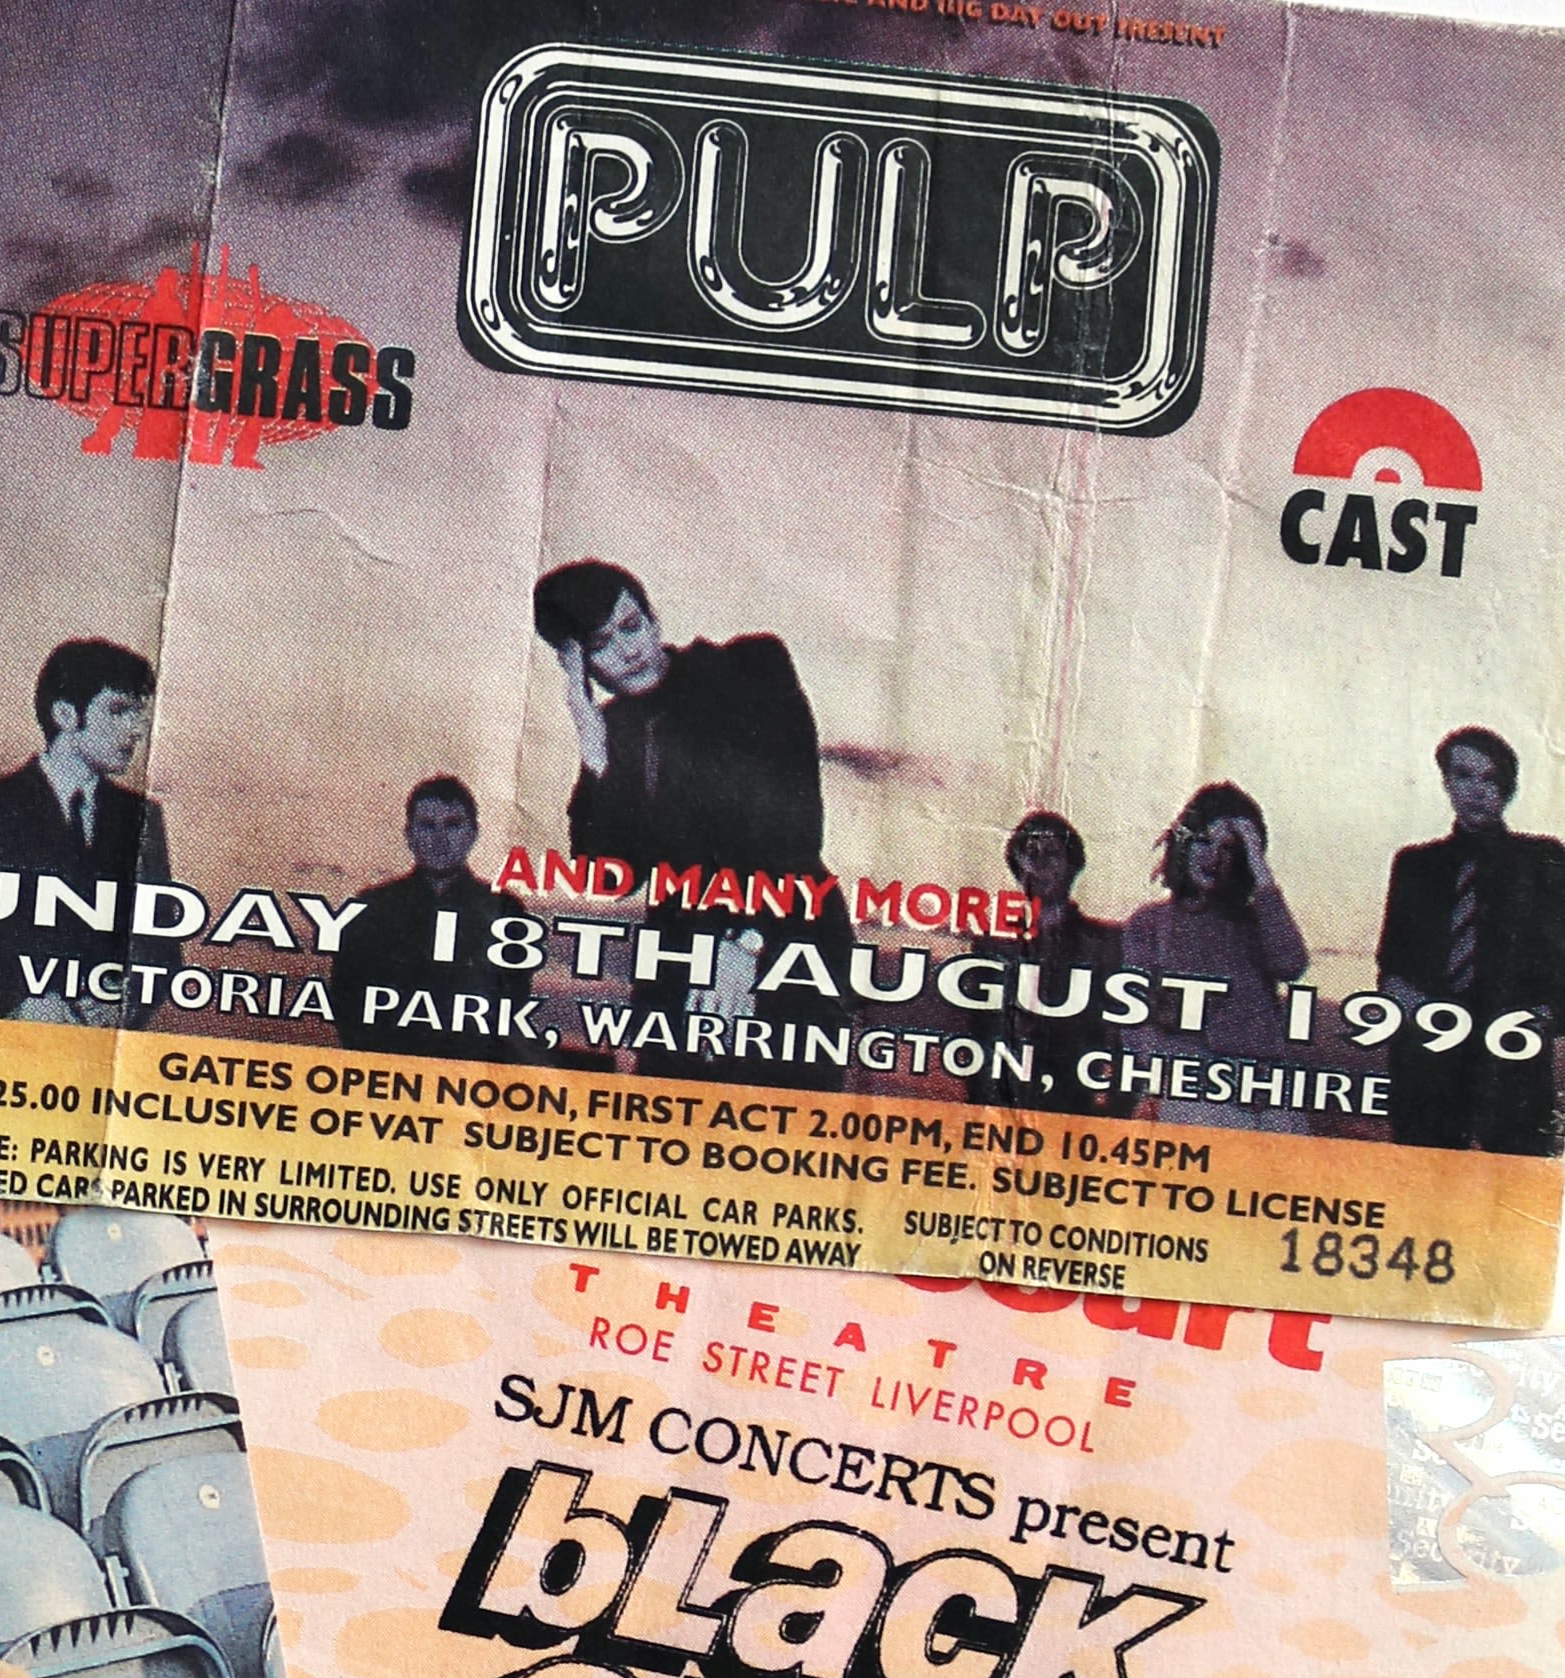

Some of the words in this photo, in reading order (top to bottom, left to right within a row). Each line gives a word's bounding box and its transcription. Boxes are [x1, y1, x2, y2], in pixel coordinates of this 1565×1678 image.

[533, 103, 1146, 357] PULP
[1279, 488, 1478, 579] CAST
[492, 846, 634, 900] AND
[648, 862, 839, 920] MANY
[850, 876, 1041, 941] MORE!
[20, 956, 335, 1022] VICTORIA
[364, 986, 560, 1051] PARK,
[581, 1000, 1055, 1097] WARRINGTON,
[1076, 1053, 1392, 1117] CHESHIRE
[432, 906, 717, 988] 18TH
[761, 940, 1230, 1032] AUGUST
[1287, 984, 1543, 1061] 1996
[93, 1085, 297, 1133] INCLUSIVE
[310, 1108, 365, 1139] OF
[372, 1114, 444, 1144] VAT
[464, 1120, 636, 1162] SUBJECT
[702, 1143, 888, 1182] BOOKING
[901, 1158, 976, 1190] FEE.
[992, 1167, 1157, 1208] SUBJECT
[1226, 1188, 1386, 1229] LICENSE
[159, 1053, 292, 1091] GATES
[306, 1068, 422, 1103] OPEN
[437, 1077, 579, 1121] NOON,
[587, 1087, 703, 1127] FIRST
[709, 1101, 797, 1135] ACT
[809, 1109, 953, 1154] 2.00PM,
[963, 1121, 1044, 1155] END
[1061, 1132, 1211, 1172] 10.45PM
[30, 1138, 148, 1172] PARKING
[199, 1153, 266, 1183] VERY
[280, 1161, 396, 1194] LIMITED.
[410, 1171, 461, 1199] USE
[475, 1176, 549, 1208] ONLY
[561, 1183, 688, 1221] OFFICIAL
[703, 1198, 758, 1226] CAR
[773, 1202, 863, 1234] PARKS.
[109, 1178, 210, 1212] PARKED
[254, 1192, 450, 1233] SURROUNDING
[458, 1208, 567, 1244] STREETS
[574, 1220, 637, 1250] WILL
[683, 1230, 779, 1262] TOWED
[785, 1239, 861, 1268] AWAY
[904, 1210, 1006, 1245] SUBJECT
[1048, 1224, 1209, 1263] CONDITIONS
[1023, 1256, 1126, 1290] REVERSE
[1280, 1227, 1456, 1284] 18348
[589, 1316, 673, 1365] ROE
[702, 1341, 845, 1398] STREET
[871, 1376, 1096, 1455] LIVERPOOL
[493, 1374, 633, 1443] SJM
[649, 1408, 998, 1520] CONCERTS
[1009, 1493, 1235, 1575] present
